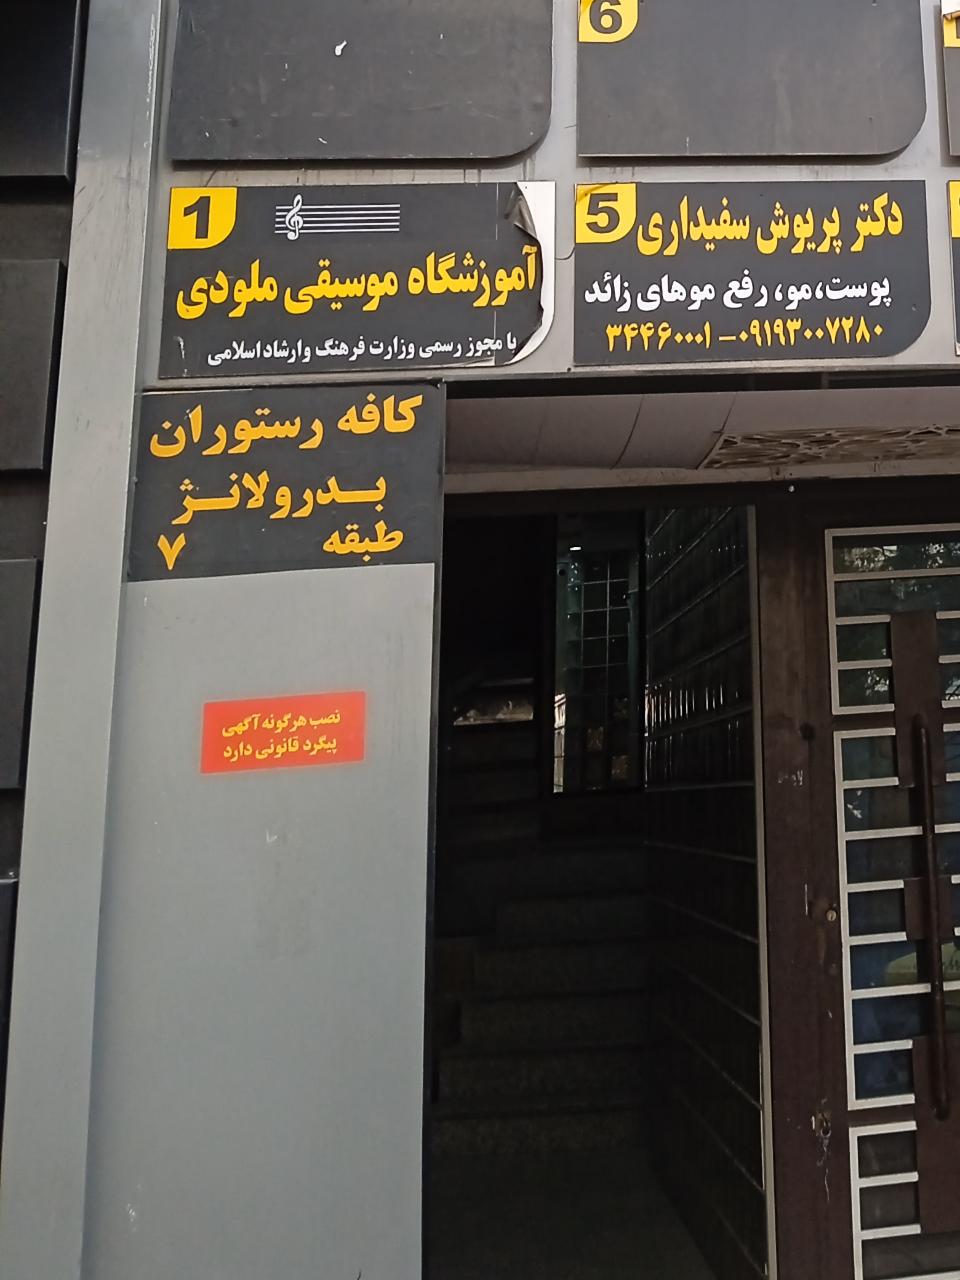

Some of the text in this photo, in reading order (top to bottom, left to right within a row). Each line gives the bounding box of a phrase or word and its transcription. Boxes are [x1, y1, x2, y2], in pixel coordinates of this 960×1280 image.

[183, 196, 211, 239] 1
[584, 192, 621, 234] 5
[636, 191, 904, 256] دکتر پریوش سفیداری
[175, 244, 539, 320] آموزشگاه موسیقی ملودی
[583, 271, 632, 312] زائد
[636, 273, 716, 311] موهای
[722, 269, 768, 309] رفع
[314, 336, 366, 362] فرهنگ
[368, 336, 415, 361] وزارت
[418, 340, 463, 360] رسمی
[465, 336, 504, 359] مجوز
[506, 332, 518, 354] با
[149, 393, 423, 458] کافه رستوران
[157, 520, 405, 571] طبقه ۷
[221, 713, 262, 738] آگهی
[309, 709, 342, 730] نصب
[223, 735, 338, 763] پیگرد قانونی دارد
